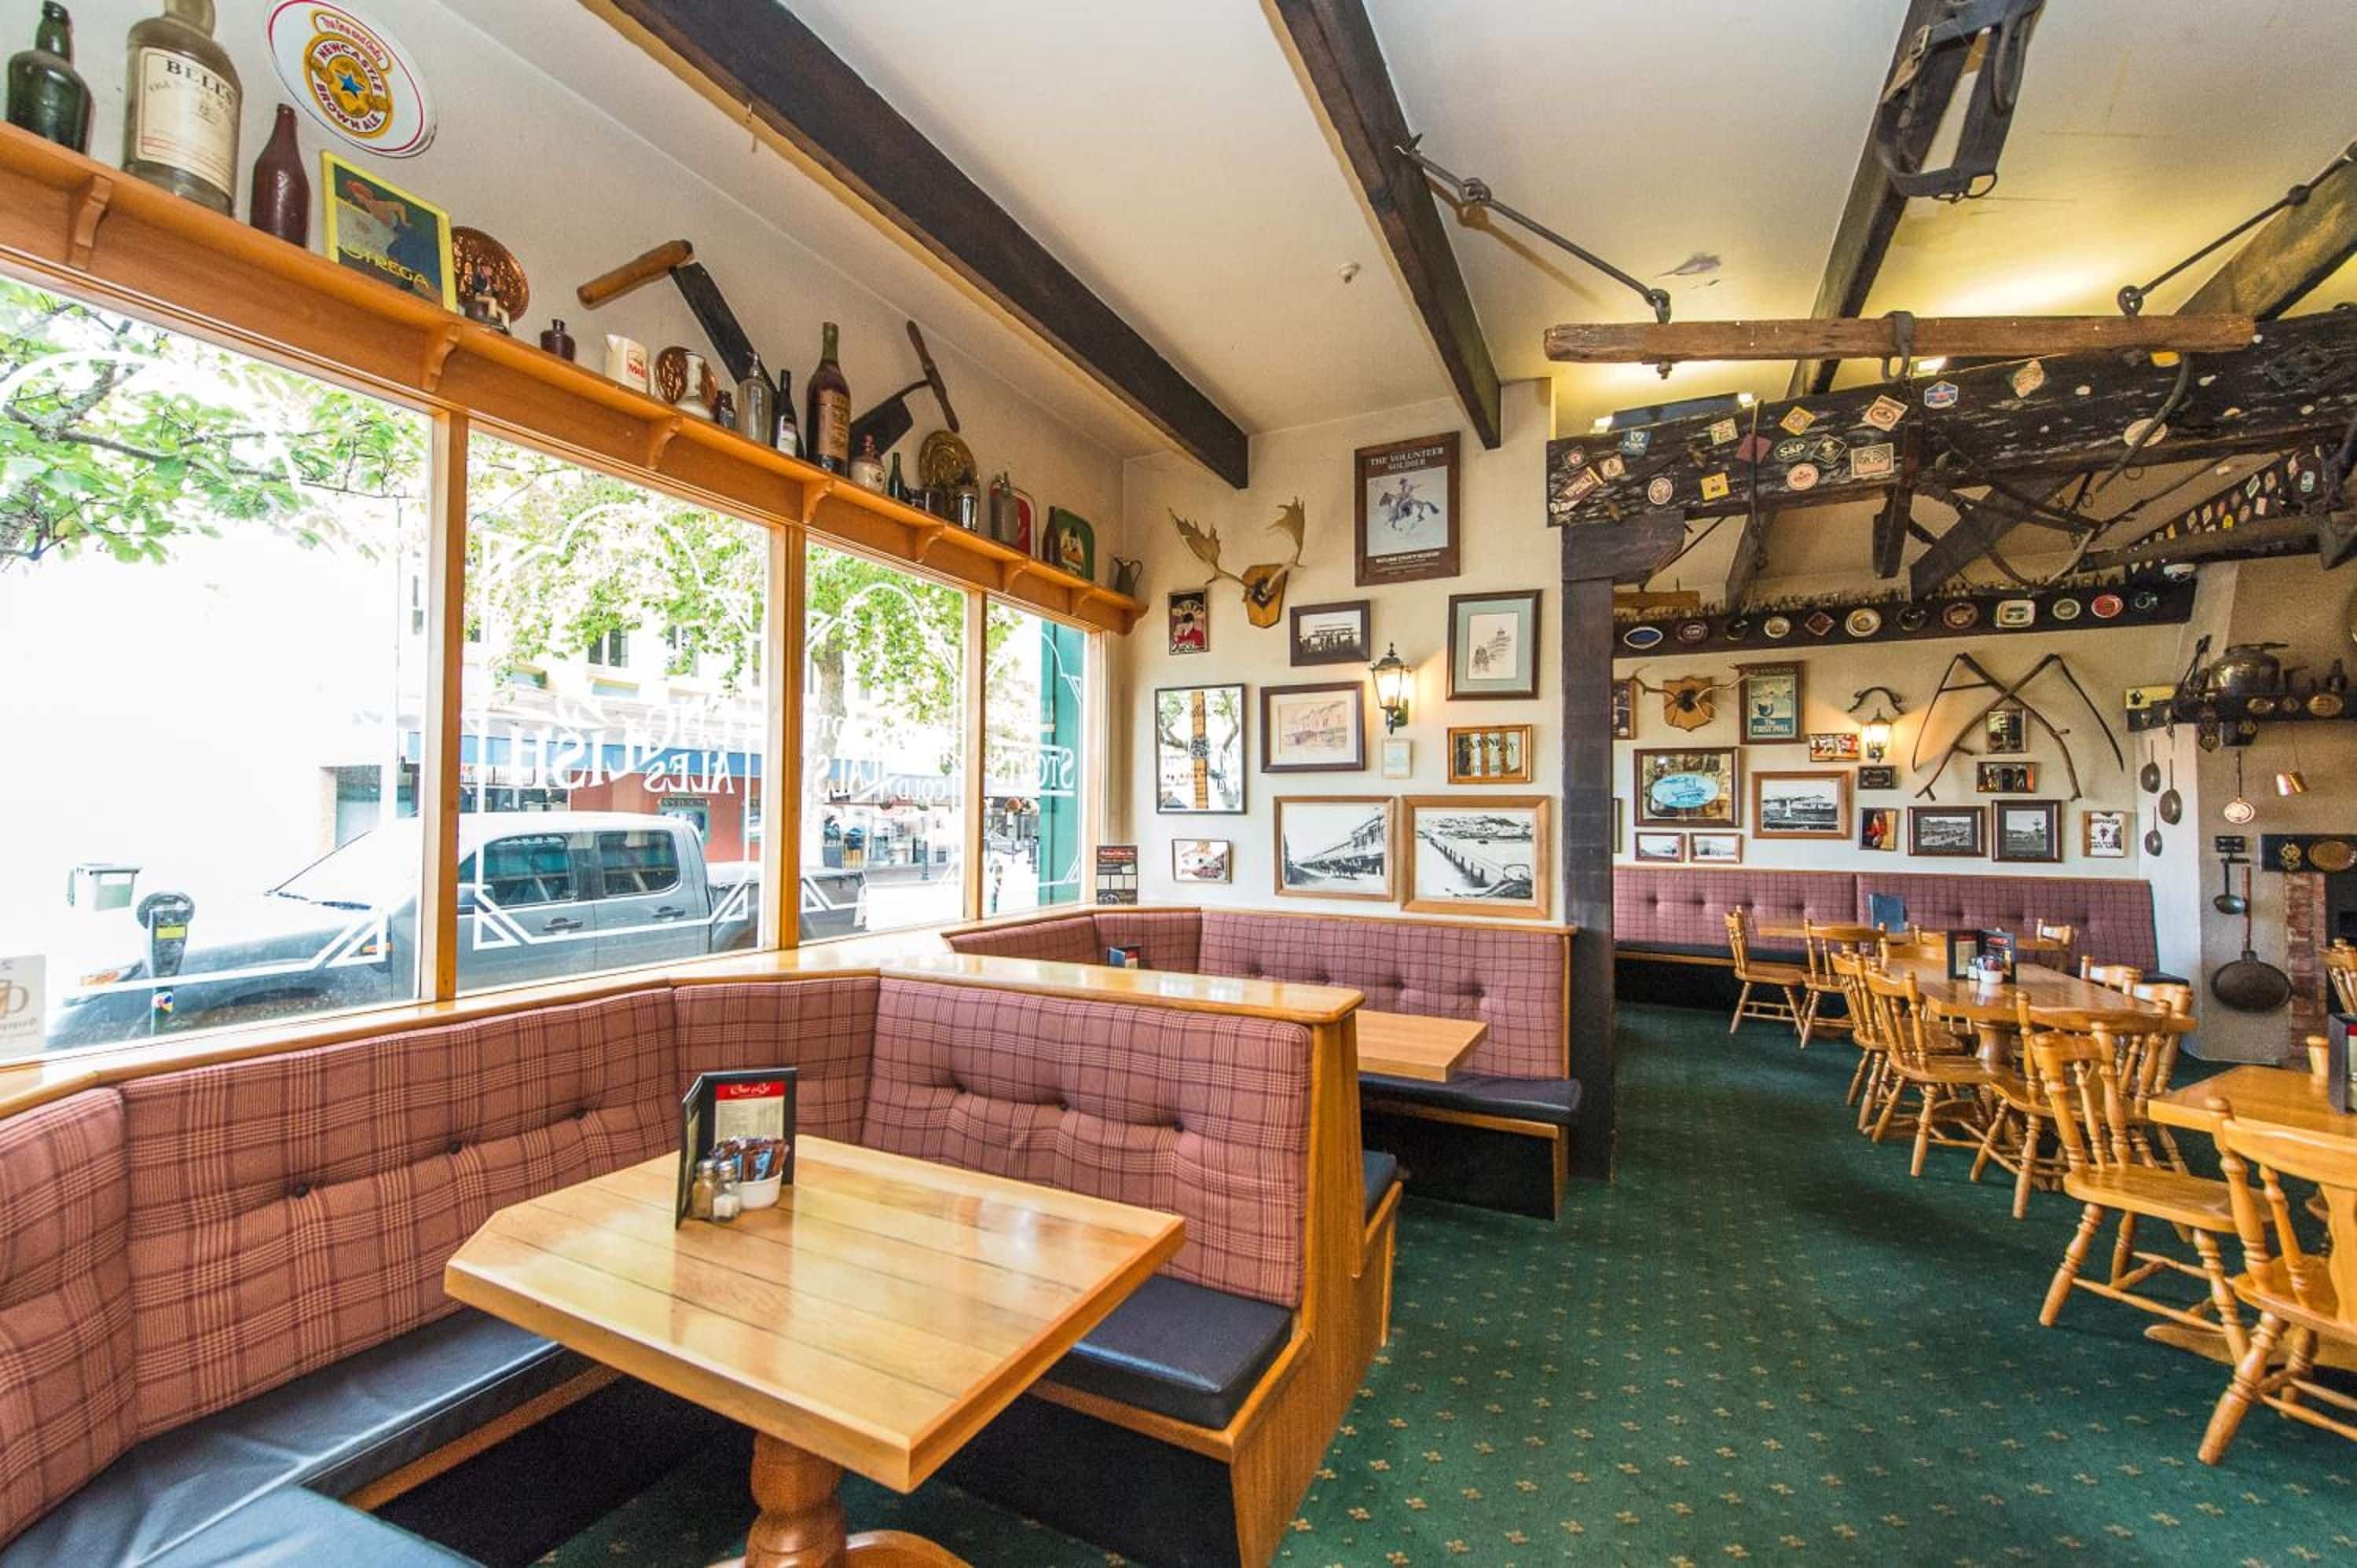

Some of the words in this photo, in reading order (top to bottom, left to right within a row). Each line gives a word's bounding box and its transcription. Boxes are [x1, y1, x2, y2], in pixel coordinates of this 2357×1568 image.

[317, 42, 383, 92] NEWCASTLE
[315, 82, 361, 130] BROWN
[361, 113, 382, 130] ALE
[1369, 456, 1388, 467] THE
[1389, 446, 1445, 463] VOLUNTEER
